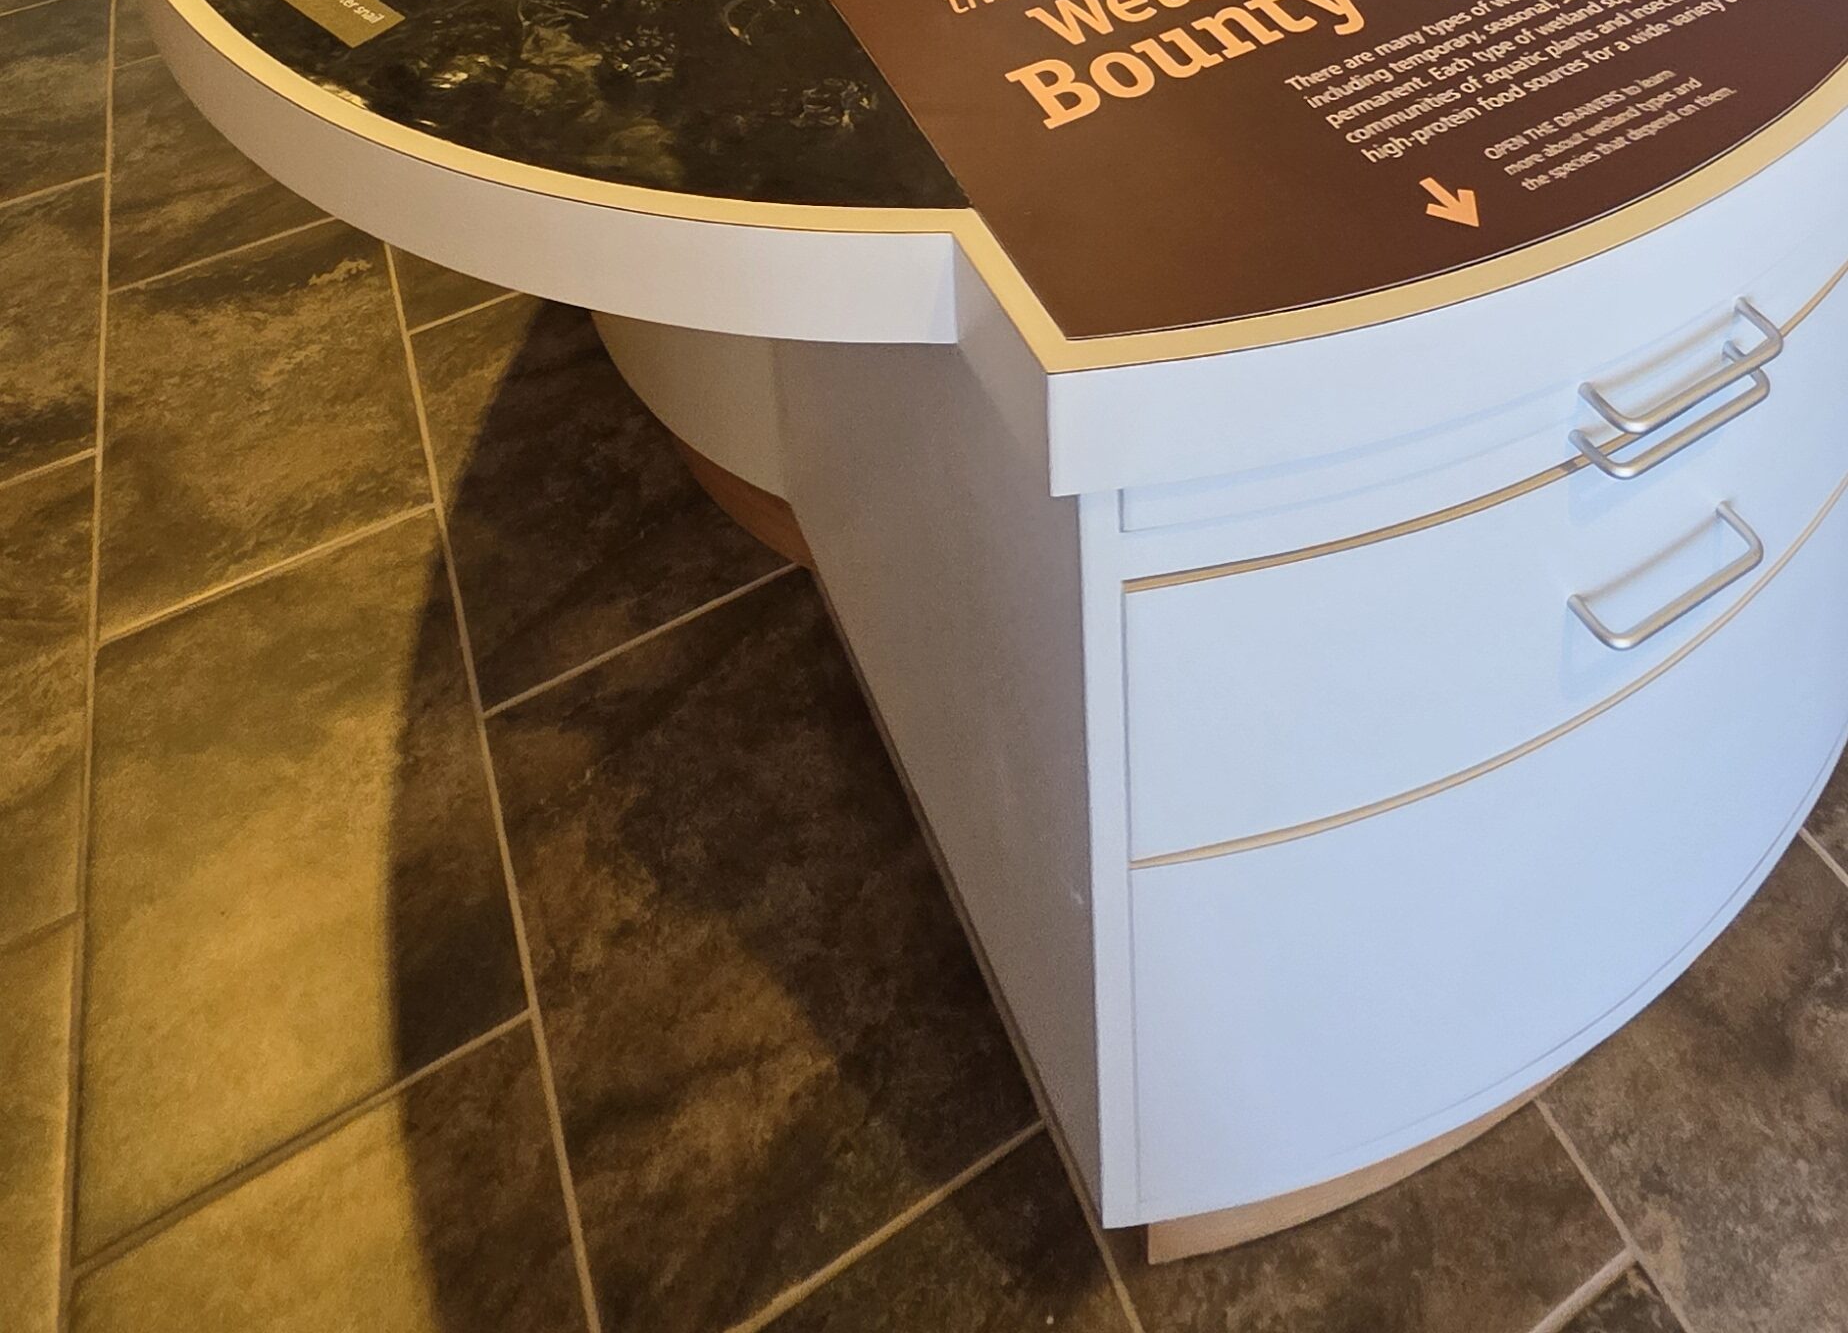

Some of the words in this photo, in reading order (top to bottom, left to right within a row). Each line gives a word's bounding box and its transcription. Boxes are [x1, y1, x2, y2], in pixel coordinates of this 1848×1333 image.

[353, 6, 385, 24] snail
[1284, 64, 1344, 90] There
[1343, 51, 1376, 69] are
[1374, 30, 1426, 56] many
[1422, 12, 1472, 36] types
[1470, 0, 1492, 17] of
[1325, 76, 1432, 129] permanent.
[1428, 57, 1475, 81] Each
[1472, 40, 1517, 62] type
[1514, 28, 1536, 45] of
[1534, 1, 1604, 35] wetland
[1303, 68, 1394, 109] including
[1389, 30, 1486, 73] temporary,
[1345, 88, 1462, 144] communities
[1459, 75, 1483, 94] of
[1482, 51, 1549, 84] aquatic
[1545, 28, 1600, 59] plants
[1596, 12, 1632, 34] and
[1360, 106, 1482, 163] high-protein
[1476, 84, 1527, 111] food
[1523, 59, 1590, 92] sources
[1582, 46, 1615, 64] for
[1613, 40, 1631, 52] a
[1626, 22, 1672, 45] wide
[1484, 134, 1530, 159] OPEN
[1523, 121, 1559, 141] THE
[1553, 90, 1626, 128] DRAWERS
[1621, 82, 1643, 96] to
[1504, 153, 1546, 176] more
[1542, 132, 1589, 158] about
[1583, 106, 1642, 138] wetland
[1636, 90, 1677, 113] types
[1672, 76, 1702, 97] and
[1521, 174, 1551, 192] the
[1548, 150, 1601, 180] species
[1595, 136, 1631, 155] that
[1626, 111, 1681, 142] depend
[1676, 103, 1701, 117] on
[1694, 86, 1737, 108] them.
